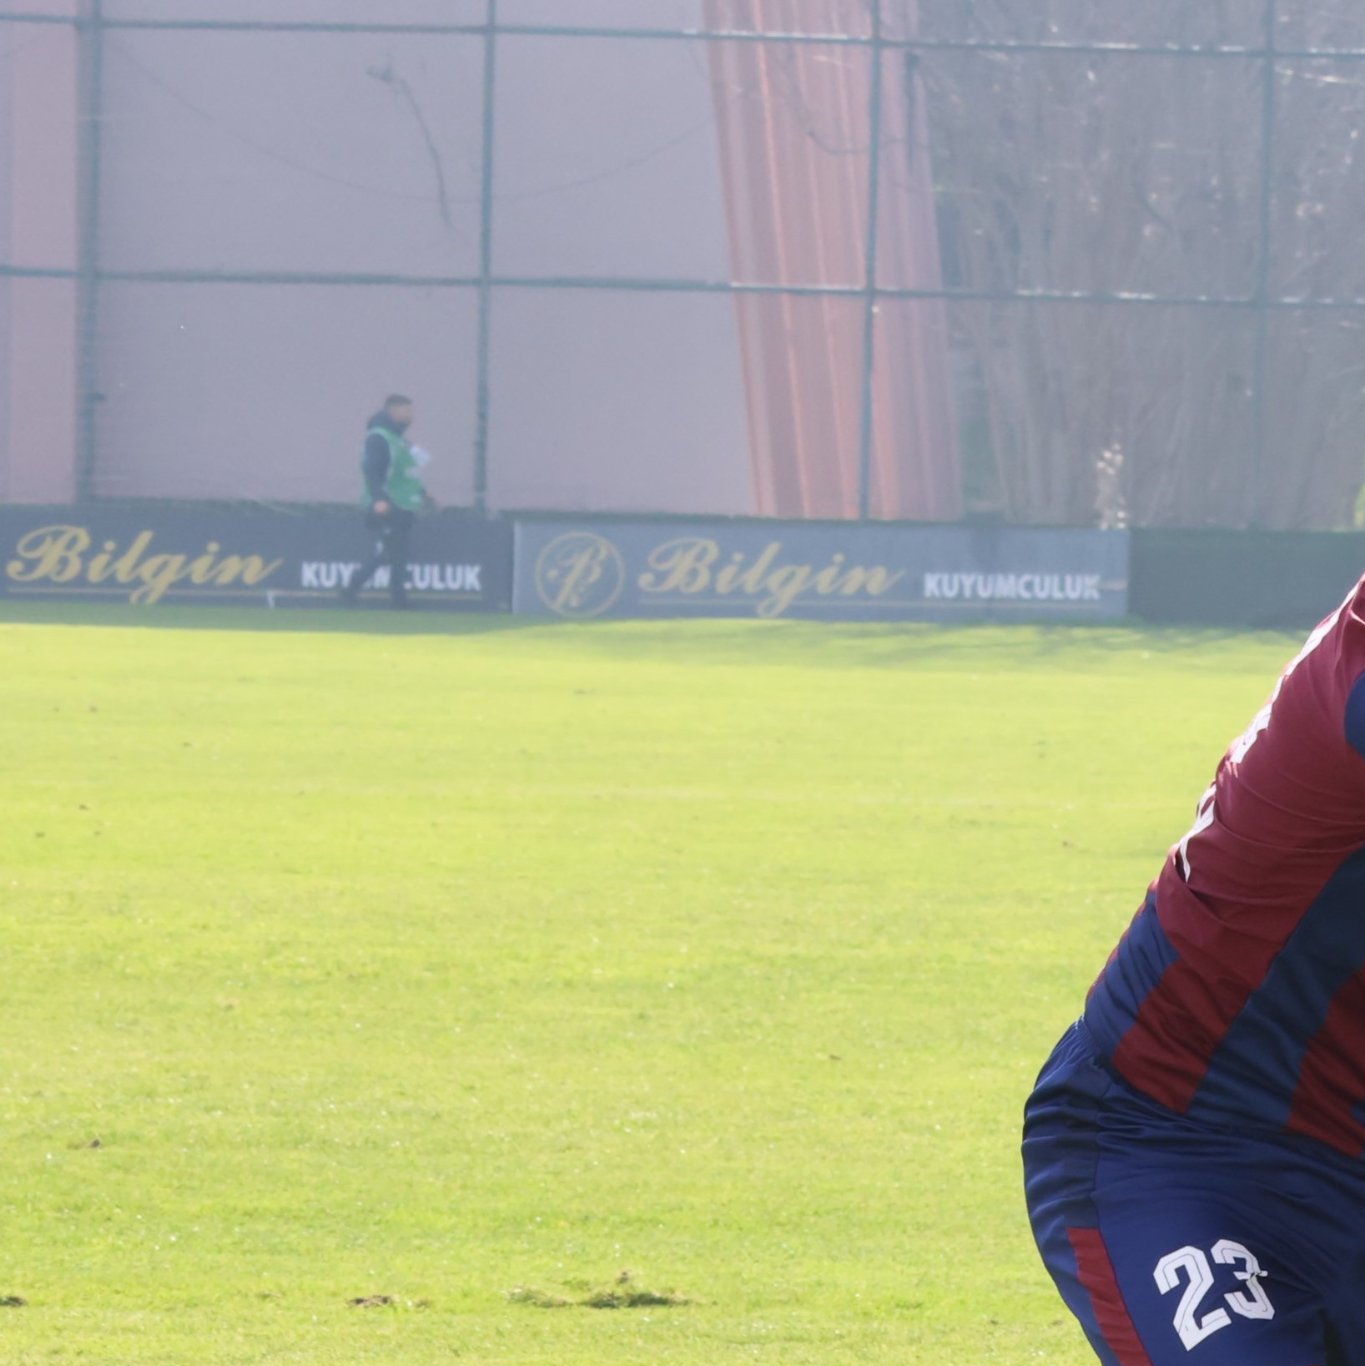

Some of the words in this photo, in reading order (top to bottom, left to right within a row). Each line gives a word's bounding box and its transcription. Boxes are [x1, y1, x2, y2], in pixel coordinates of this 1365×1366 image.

[6, 524, 283, 604] Bilgin
[301, 561, 482, 591] KUYMULUK
[638, 537, 904, 617] Bilgin
[924, 572, 1101, 600] KUYUMCULUK
[1153, 1239, 1275, 1352] 23
